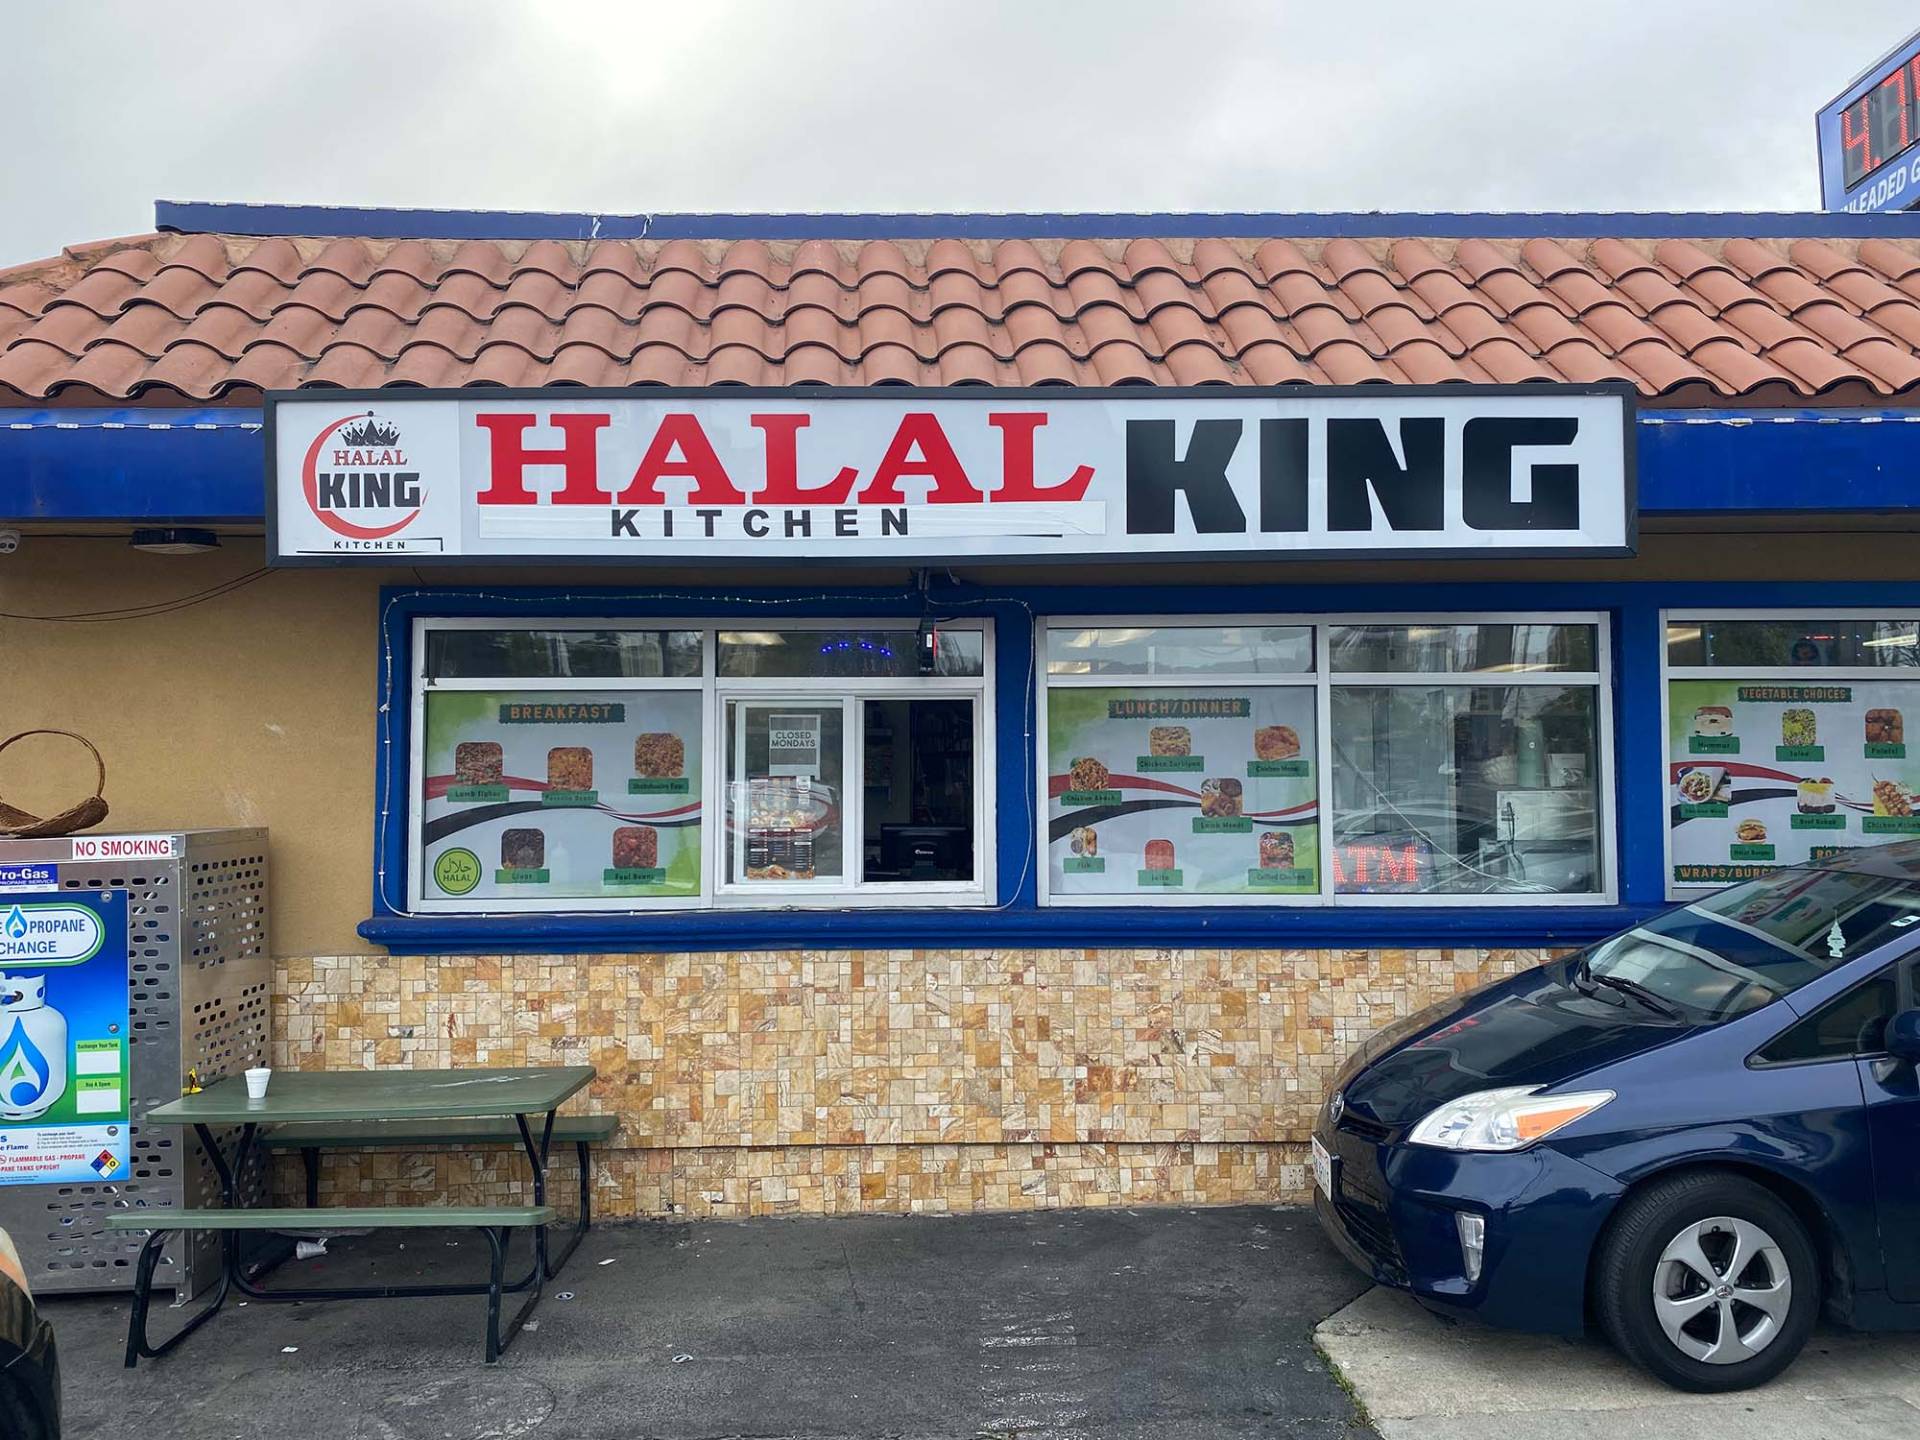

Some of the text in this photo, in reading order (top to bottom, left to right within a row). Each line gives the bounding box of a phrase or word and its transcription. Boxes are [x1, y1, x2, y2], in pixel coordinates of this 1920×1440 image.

[333, 449, 408, 466] HALAL
[476, 412, 1580, 534] HALAL KING
[319, 472, 421, 508] KING
[611, 508, 909, 538] KITCHEN
[334, 540, 406, 549] KITCHEN
[1742, 687, 1847, 699] VEGETABLE CHOICES
[510, 705, 612, 720] BREAKFAST
[1115, 700, 1243, 715] LUNCH/DINNER
[75, 839, 170, 856] NO SMOKING
[443, 874, 472, 882] HALAL
[29, 918, 86, 934] PROPANE
[6, 1143, 29, 1151] Flame
[9, 1155, 43, 1163] FLAMMABLE
[36, 1163, 60, 1171] UPRIGHT
